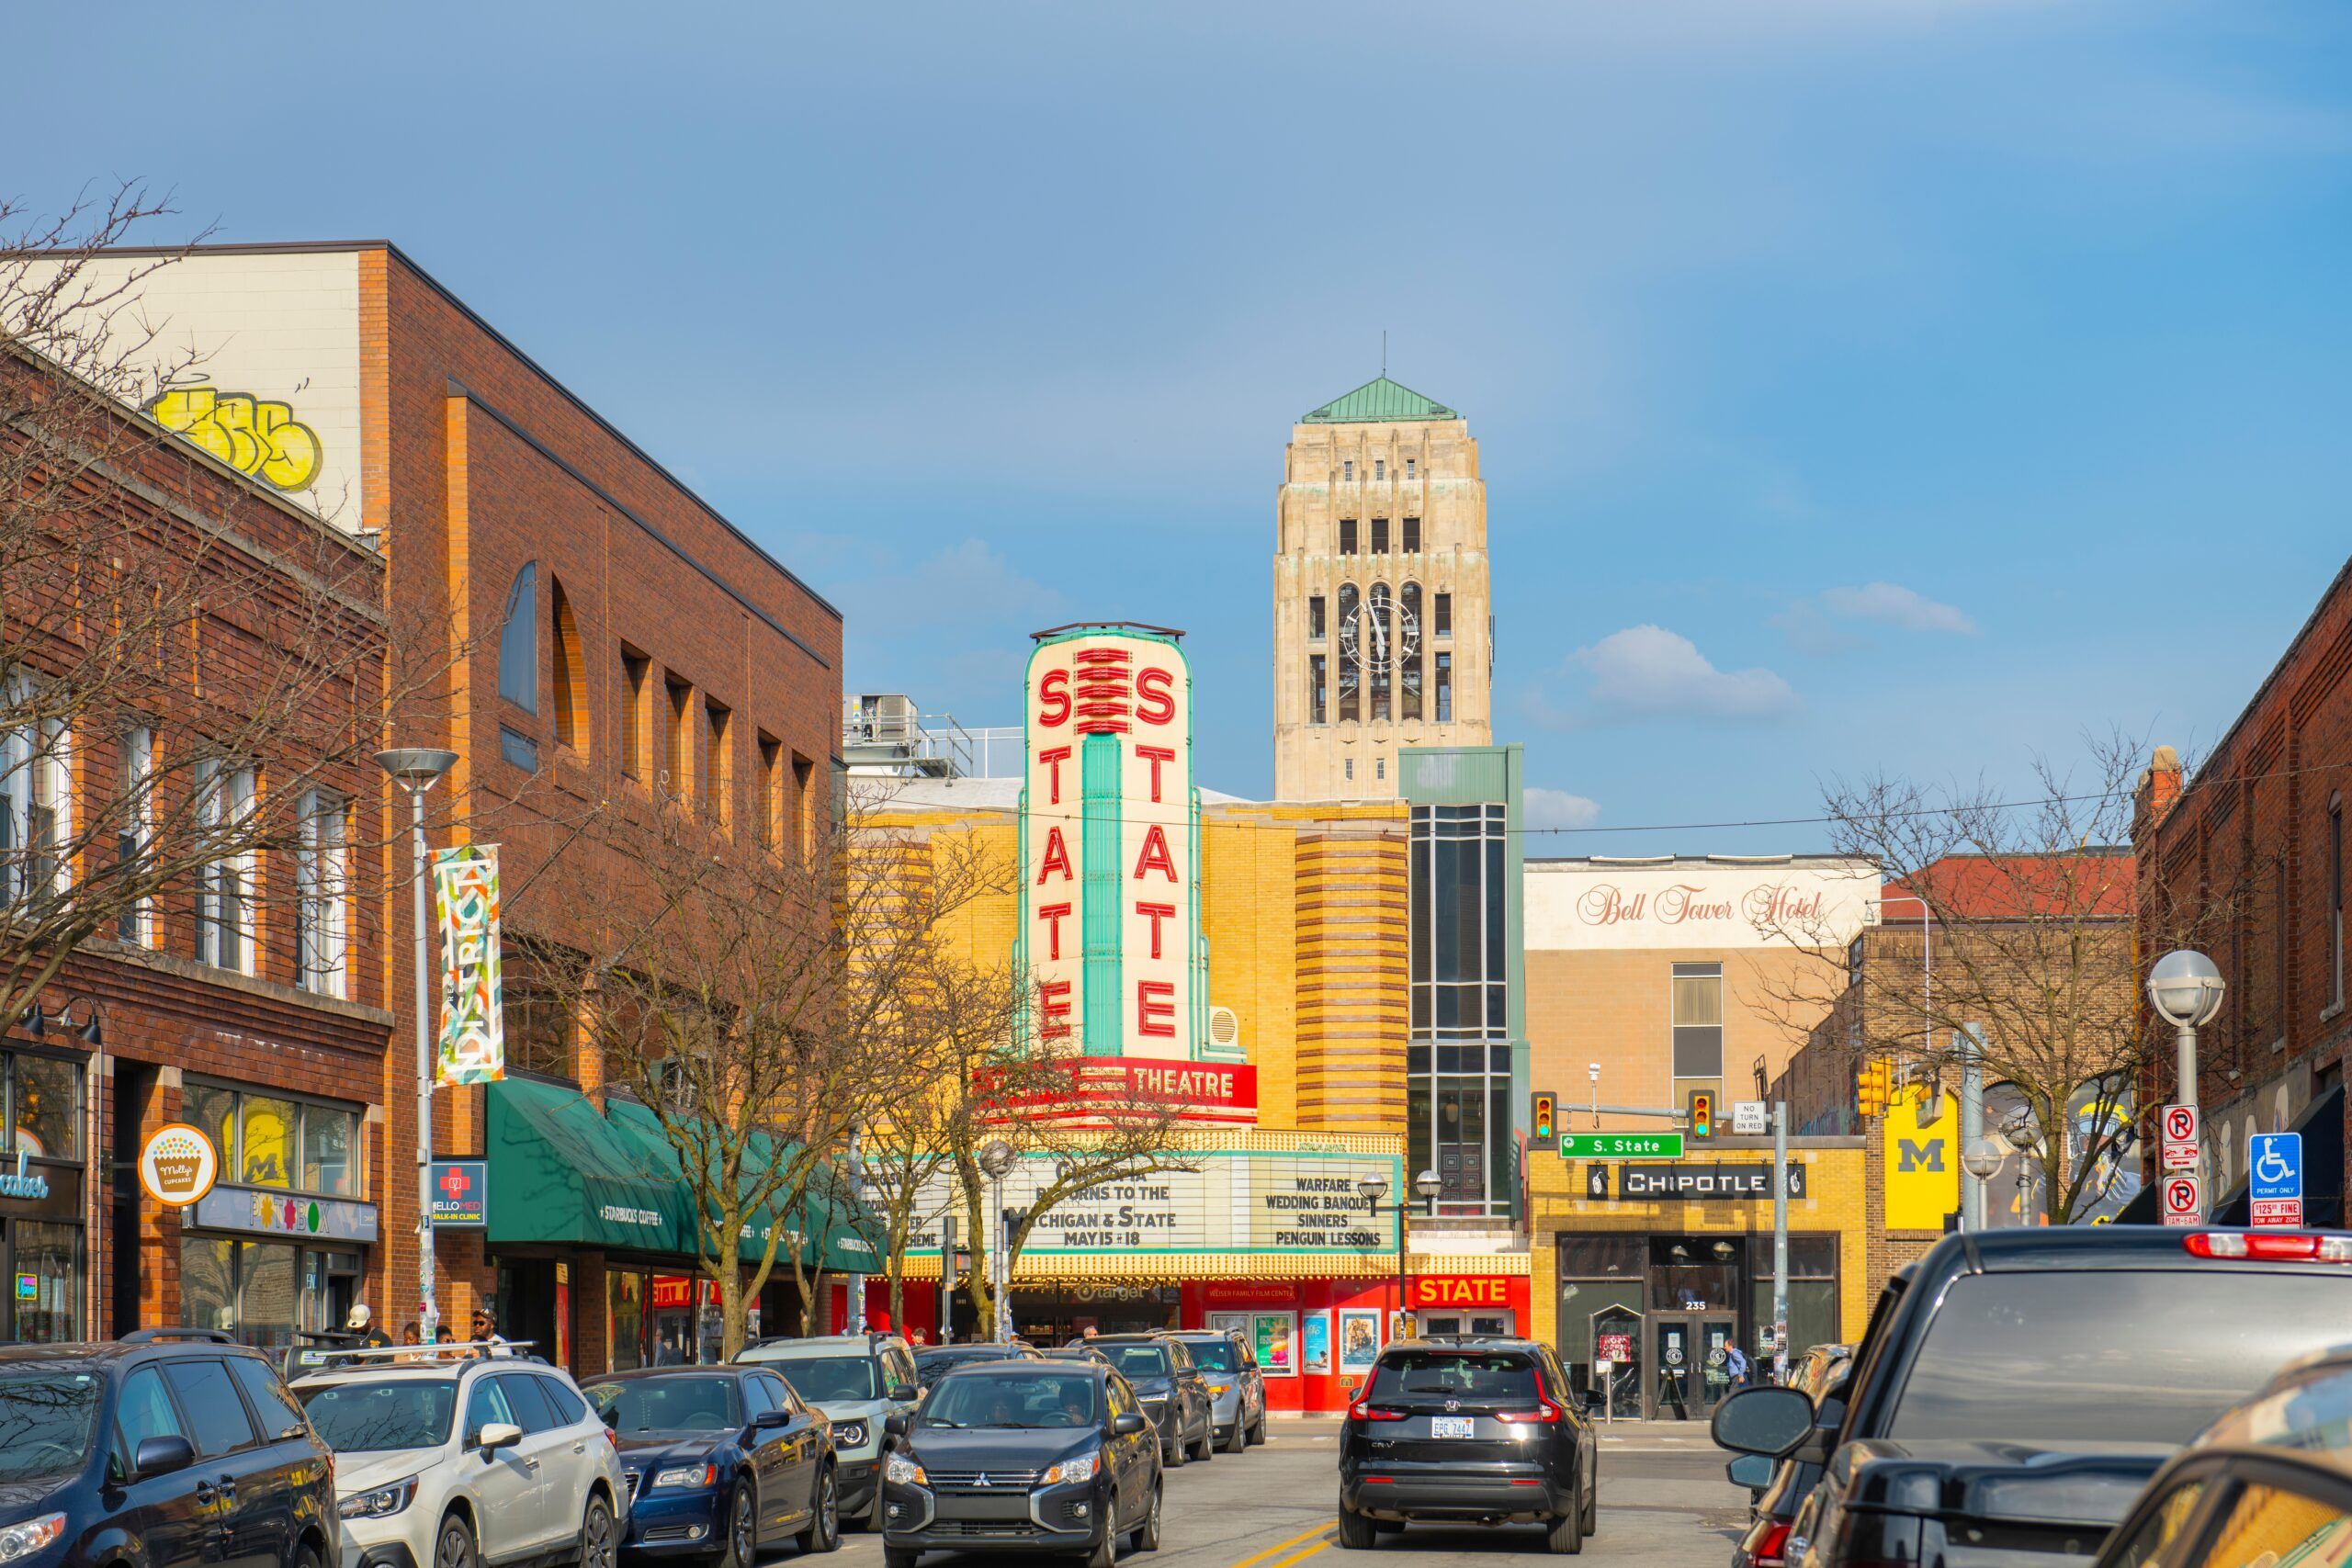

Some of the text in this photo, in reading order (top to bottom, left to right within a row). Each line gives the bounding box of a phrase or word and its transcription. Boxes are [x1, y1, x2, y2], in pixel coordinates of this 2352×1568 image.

[1037, 669, 1073, 1039] STATE
[1134, 667, 1179, 1038] STATE
[1577, 884, 1822, 926] Bell Tower Hotel
[456, 873, 485, 1058] DISTRICT
[1133, 1067, 1234, 1099] THEATRE
[1593, 1139, 1660, 1152] S. State
[1898, 1138, 1945, 1172] M
[160, 1164, 193, 1177] Molly's
[164, 1177, 192, 1185] CUPCAKES
[1296, 1178, 1351, 1192] WARFARE
[1627, 1173, 1767, 1192] CHIPOTLE
[1035, 1186, 1170, 1201] RURNS TO THE
[1266, 1195, 1373, 1210] WEDDING BANQUE
[2281, 1203, 2298, 1213] FINE
[459, 1213, 481, 1221] CLINIC
[605, 1205, 658, 1226] STARBUCKS COFFEE
[1297, 1213, 1348, 1228] SINNERS
[1064, 1232, 1098, 1246] MAY
[1275, 1232, 1381, 1246] PENGUIN LESSONS
[1097, 1283, 1144, 1301] target
[1419, 1279, 1506, 1302] STATE
[1686, 1301, 1706, 1310] 235
